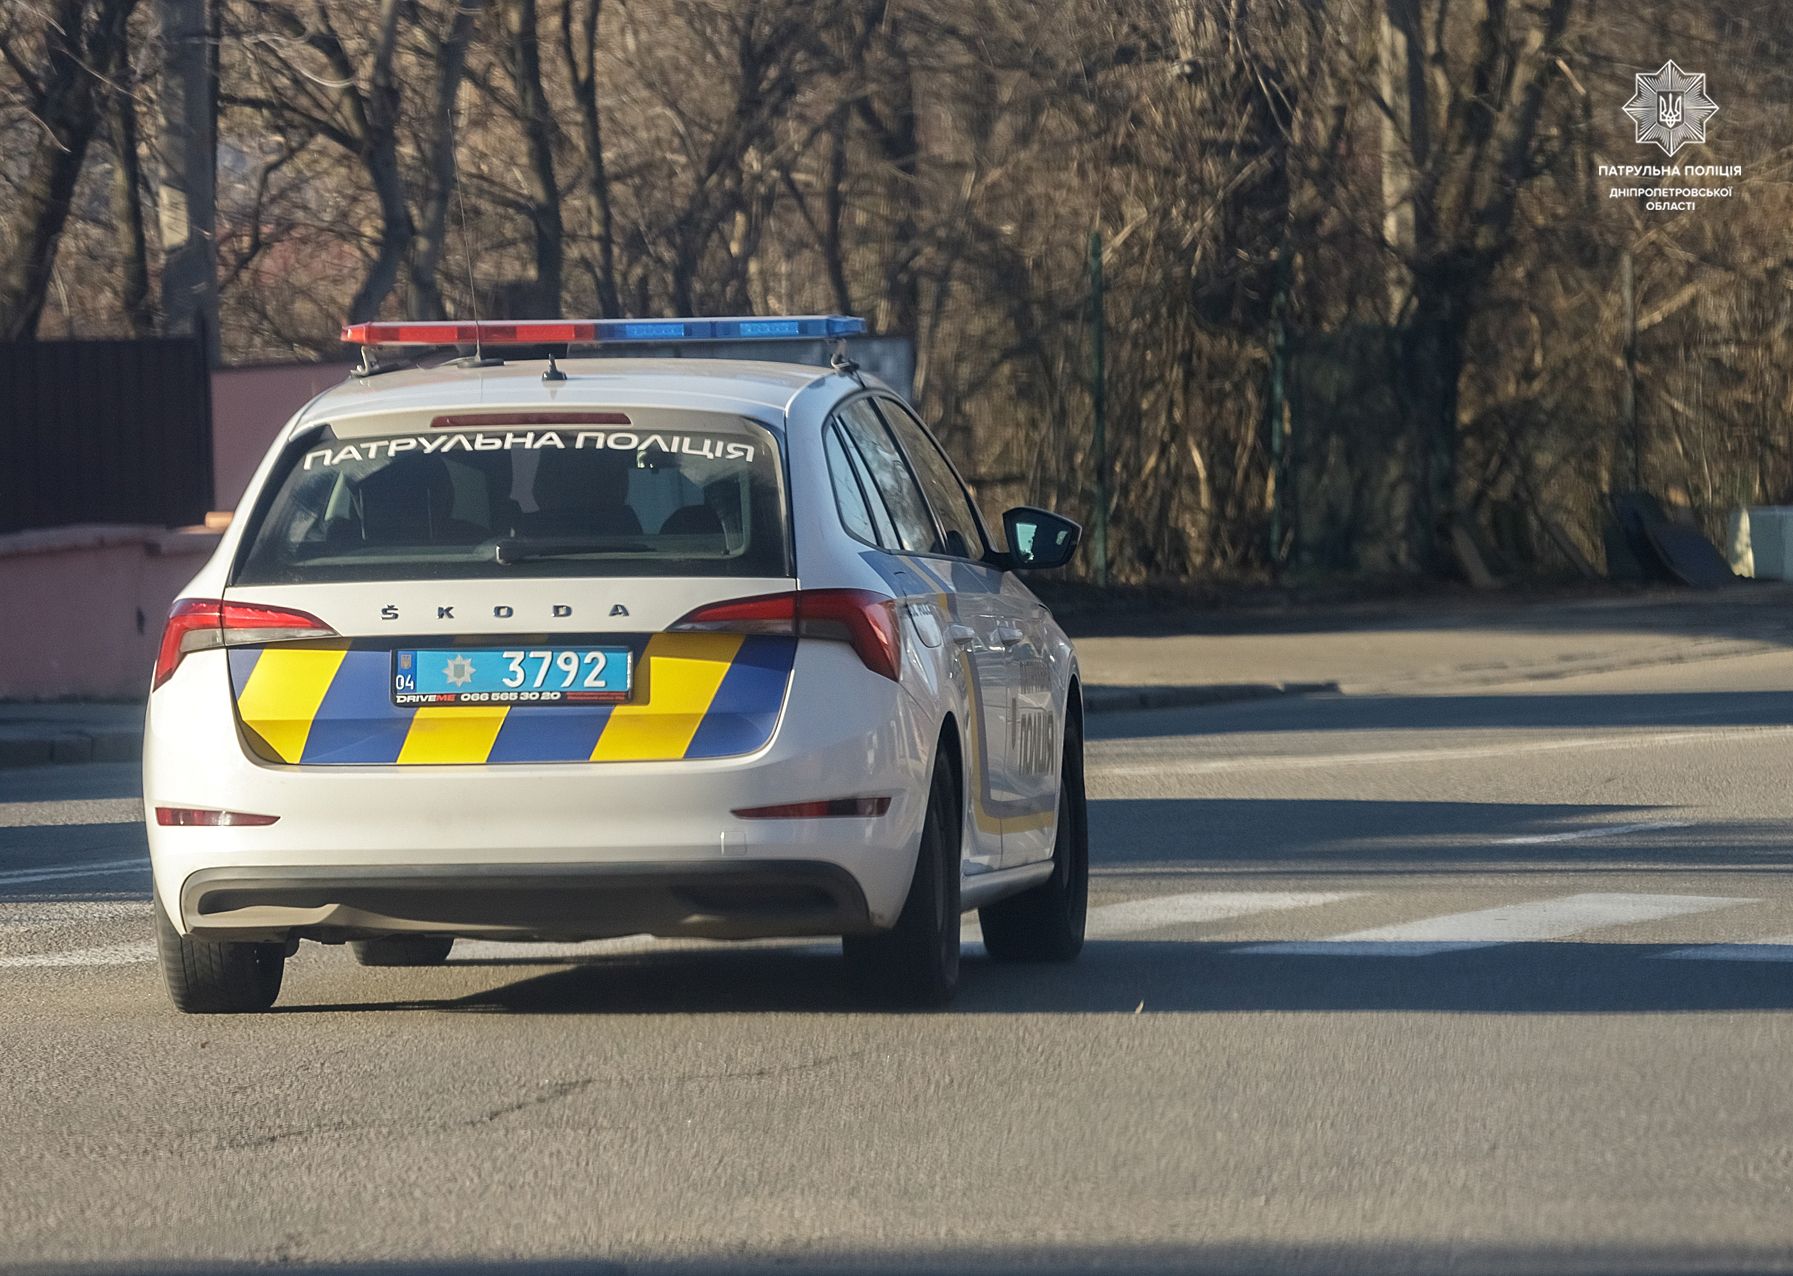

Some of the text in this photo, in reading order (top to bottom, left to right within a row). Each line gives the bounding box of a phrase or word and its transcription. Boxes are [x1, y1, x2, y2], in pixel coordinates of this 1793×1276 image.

[303, 431, 755, 470] ПАТРУЛЬНА ПОЛІЦІЯ
[380, 604, 630, 621] ŠKODA
[502, 650, 608, 689] 3792
[395, 674, 414, 690] 04
[396, 693, 456, 704] DRIVEME
